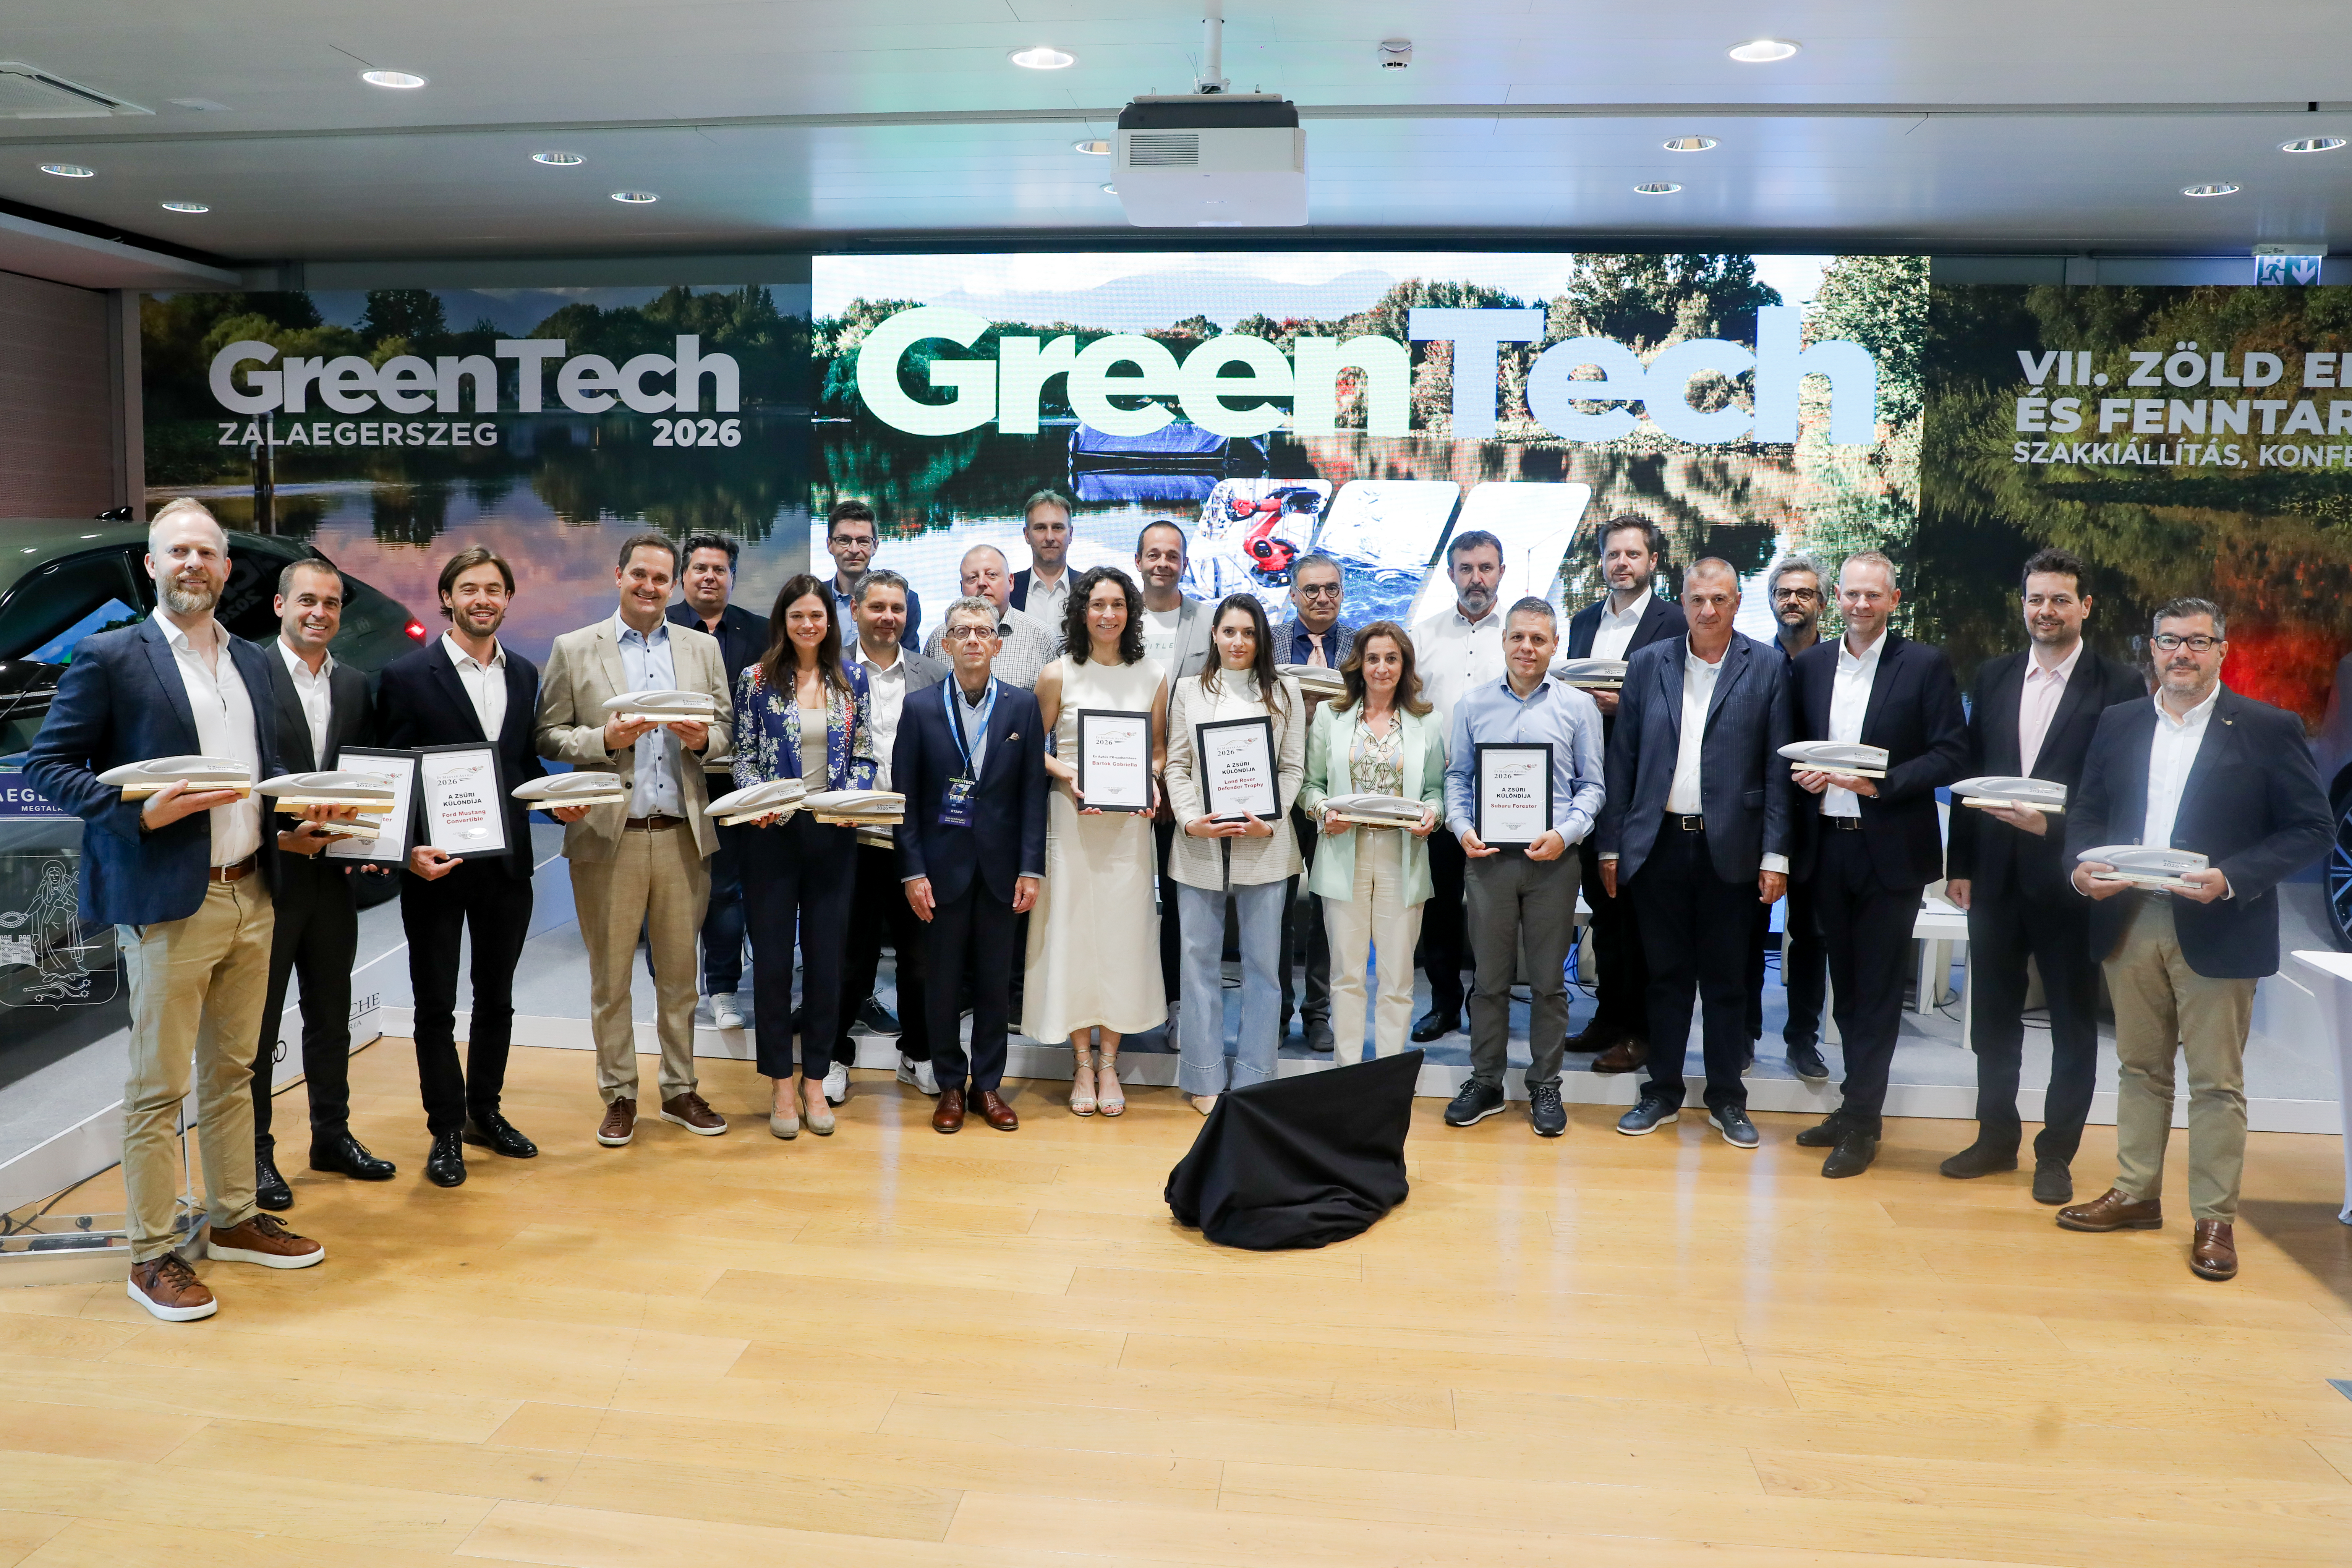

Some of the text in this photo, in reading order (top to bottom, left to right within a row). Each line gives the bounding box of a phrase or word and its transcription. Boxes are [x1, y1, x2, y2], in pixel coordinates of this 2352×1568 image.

[209, 335, 740, 414] GreenTech
[857, 306, 1876, 444] GreenTech
[2017, 350, 2109, 387] VII.
[2127, 341, 2284, 388] ZÖLD
[2016, 387, 2352, 435] ÉS FENNTAR
[219, 423, 498, 446] ZALAEGERSZEG
[652, 419, 741, 447] 2026
[2013, 437, 2248, 468] SZAKKIÁLLÍTÁS,
[982, 703, 992, 722] GreenTech
[949, 778, 975, 786] GREENTECH
[443, 799, 482, 807] KÜLÖNDÍJA
